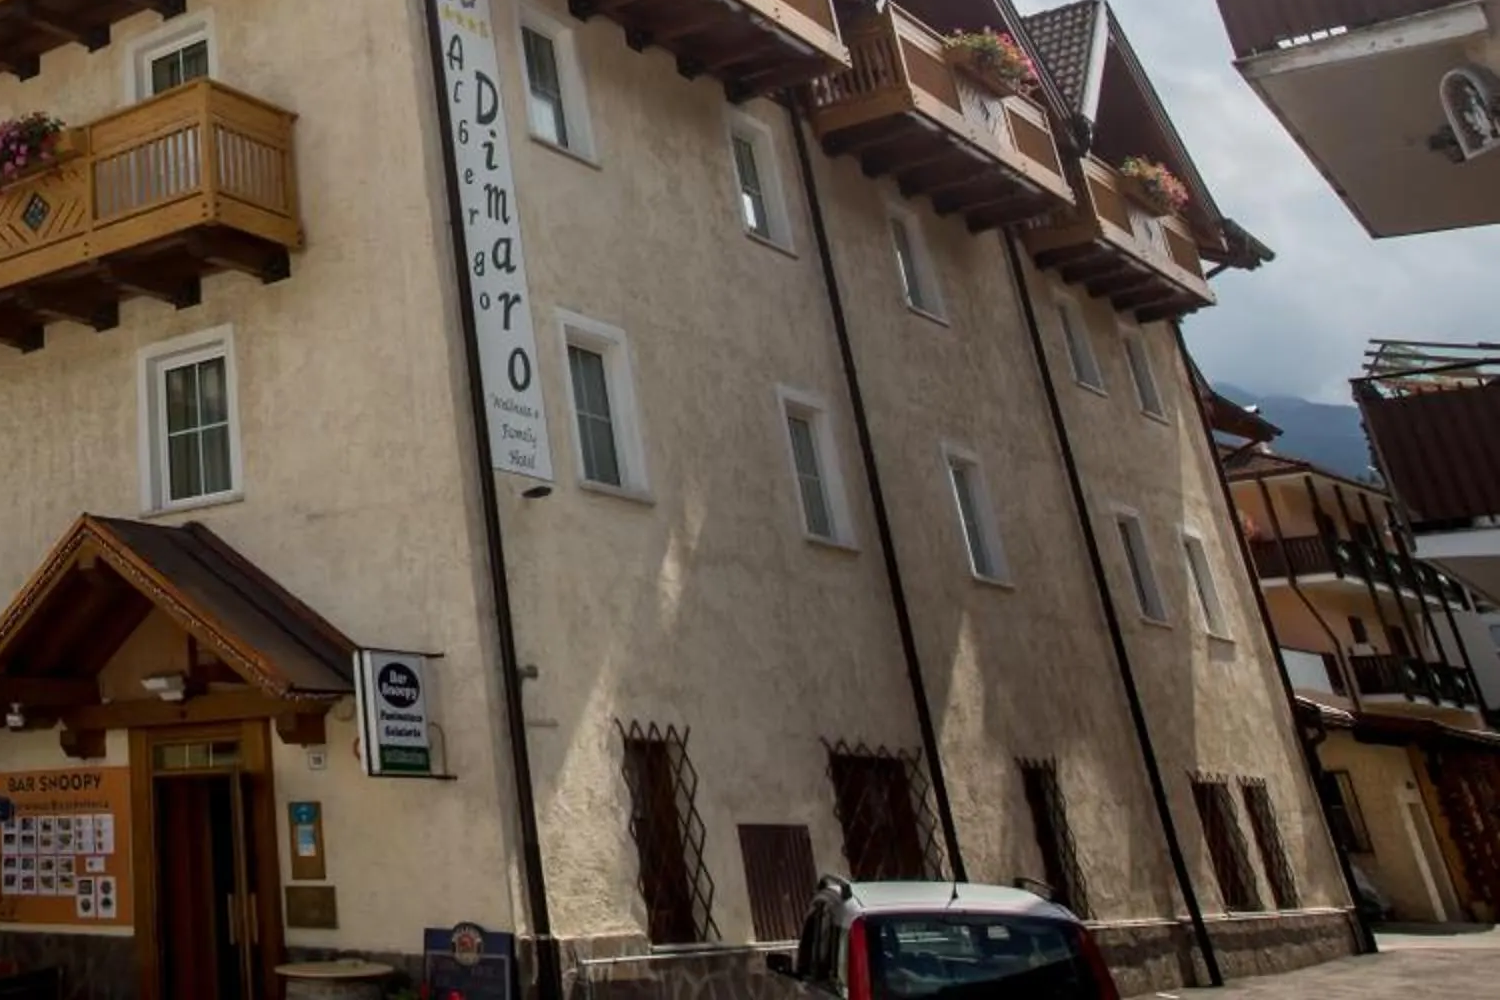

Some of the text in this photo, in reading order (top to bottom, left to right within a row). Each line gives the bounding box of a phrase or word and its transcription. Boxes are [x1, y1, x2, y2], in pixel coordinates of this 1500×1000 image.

[475, 70, 532, 392] Dimaro
[7, 773, 102, 793] BAR SNOOPY
